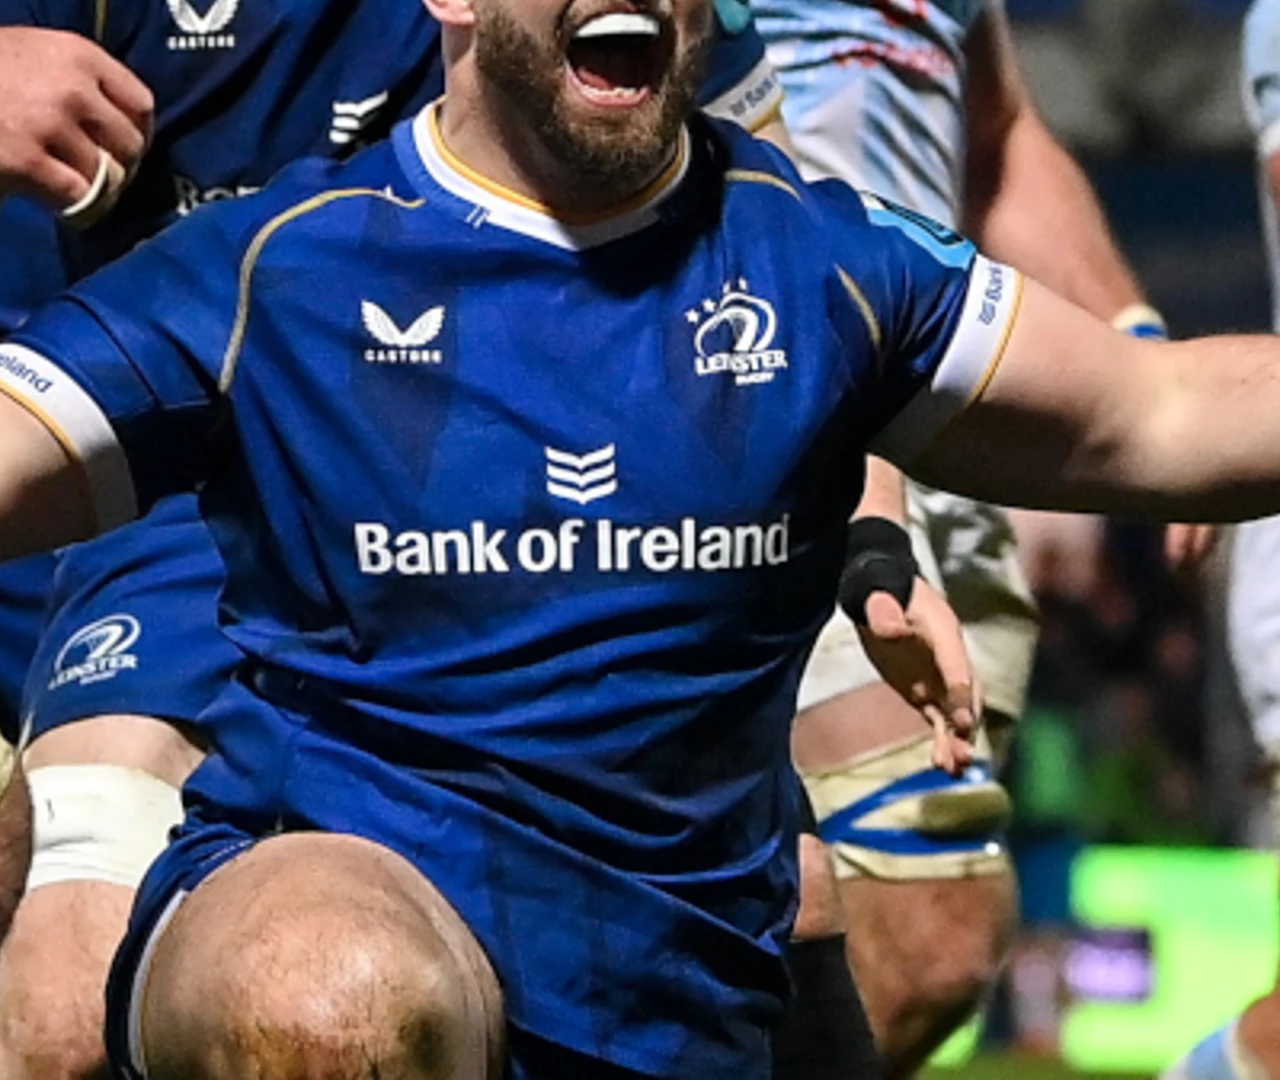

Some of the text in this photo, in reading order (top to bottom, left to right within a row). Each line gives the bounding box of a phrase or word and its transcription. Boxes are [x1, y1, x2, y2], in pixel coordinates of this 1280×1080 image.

[354, 513, 791, 575] Bank of Ireland
